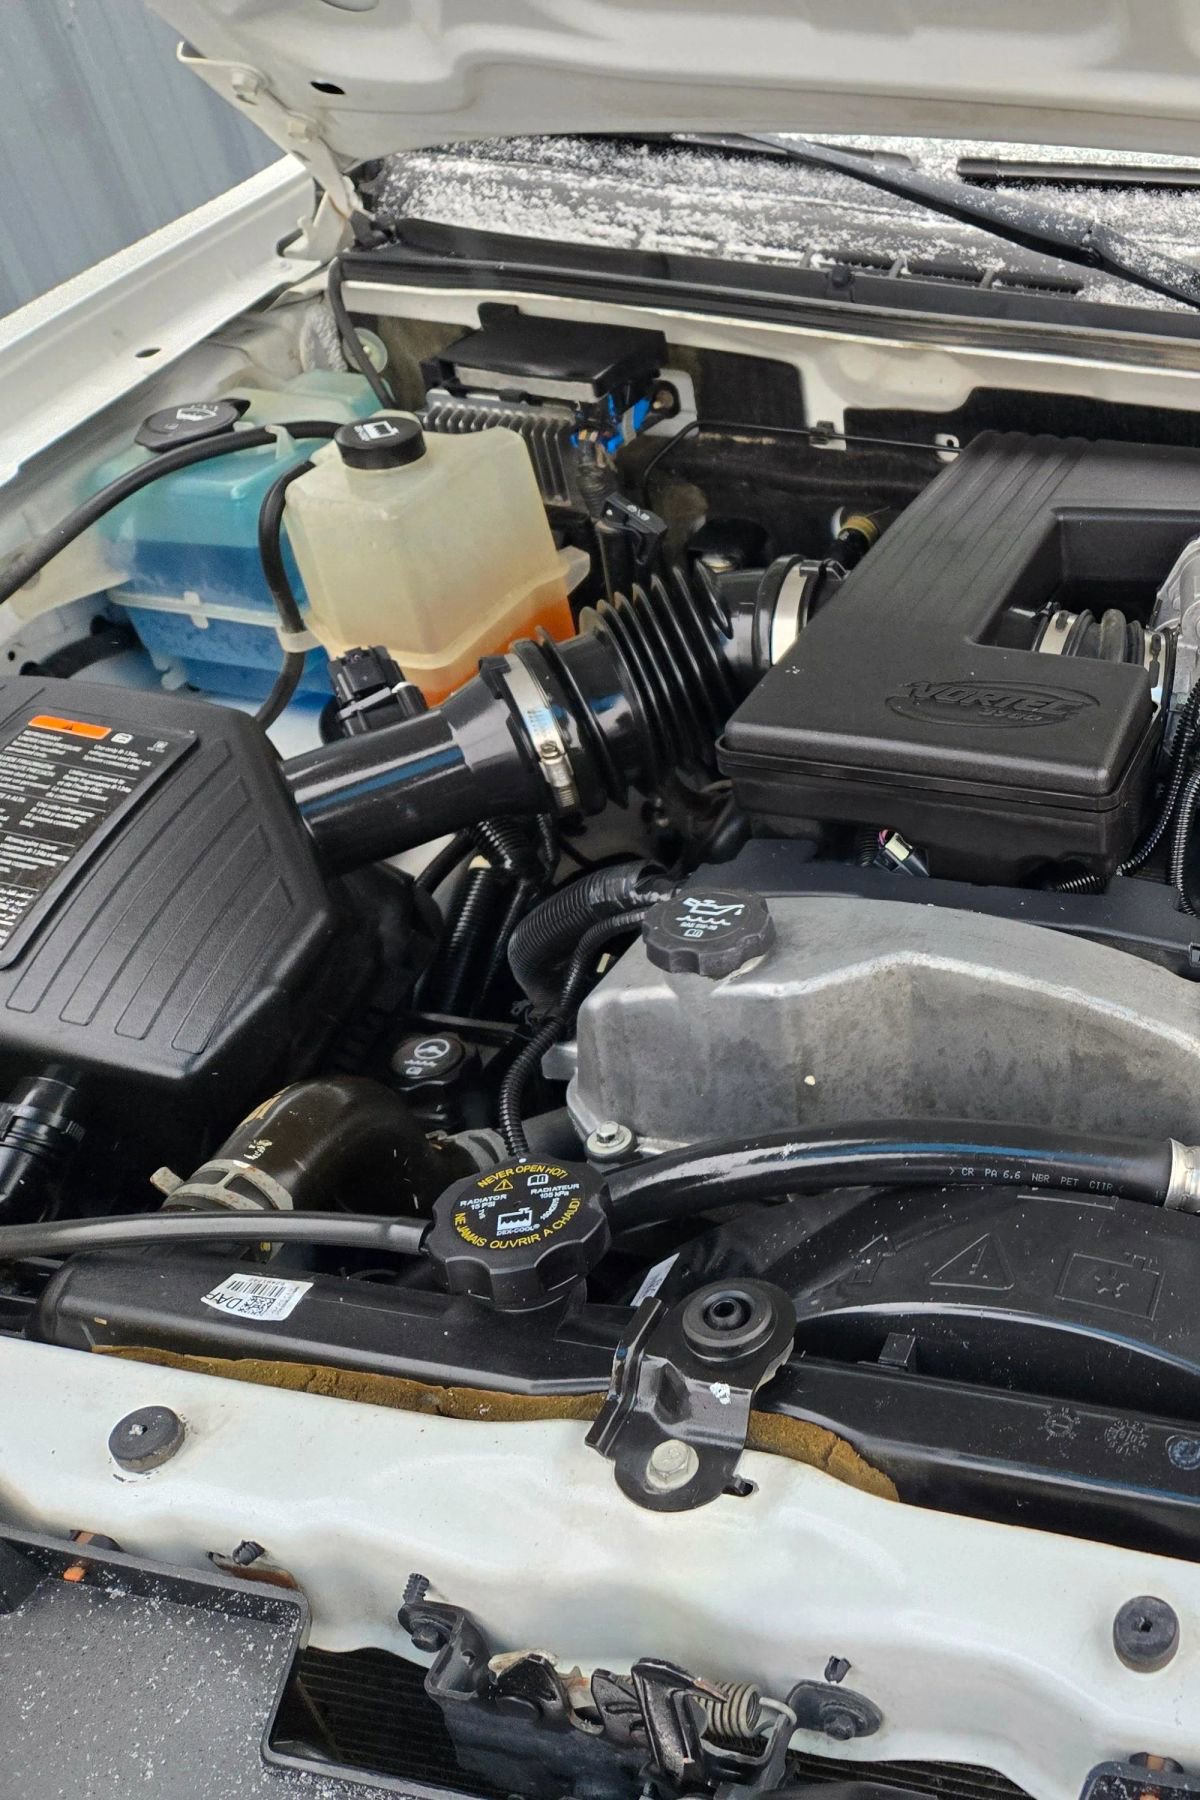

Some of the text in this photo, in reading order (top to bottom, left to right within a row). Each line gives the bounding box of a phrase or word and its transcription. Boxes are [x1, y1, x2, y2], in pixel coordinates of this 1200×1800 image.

[907, 682, 1083, 716] VORTEC
[477, 1164, 569, 1188] NEVER OPEN HOT!
[961, 1167, 975, 1177] CR
[984, 1168, 998, 1179] PA
[1002, 1169, 1021, 1180] 6.6
[1060, 1176, 1079, 1187] PET
[530, 1183, 580, 1195] RADIATEUR
[459, 1193, 508, 1207] RADIATOR
[454, 1212, 467, 1226] NE
[456, 1225, 488, 1247] JAMAIS
[489, 1233, 541, 1249] OUVRIR
